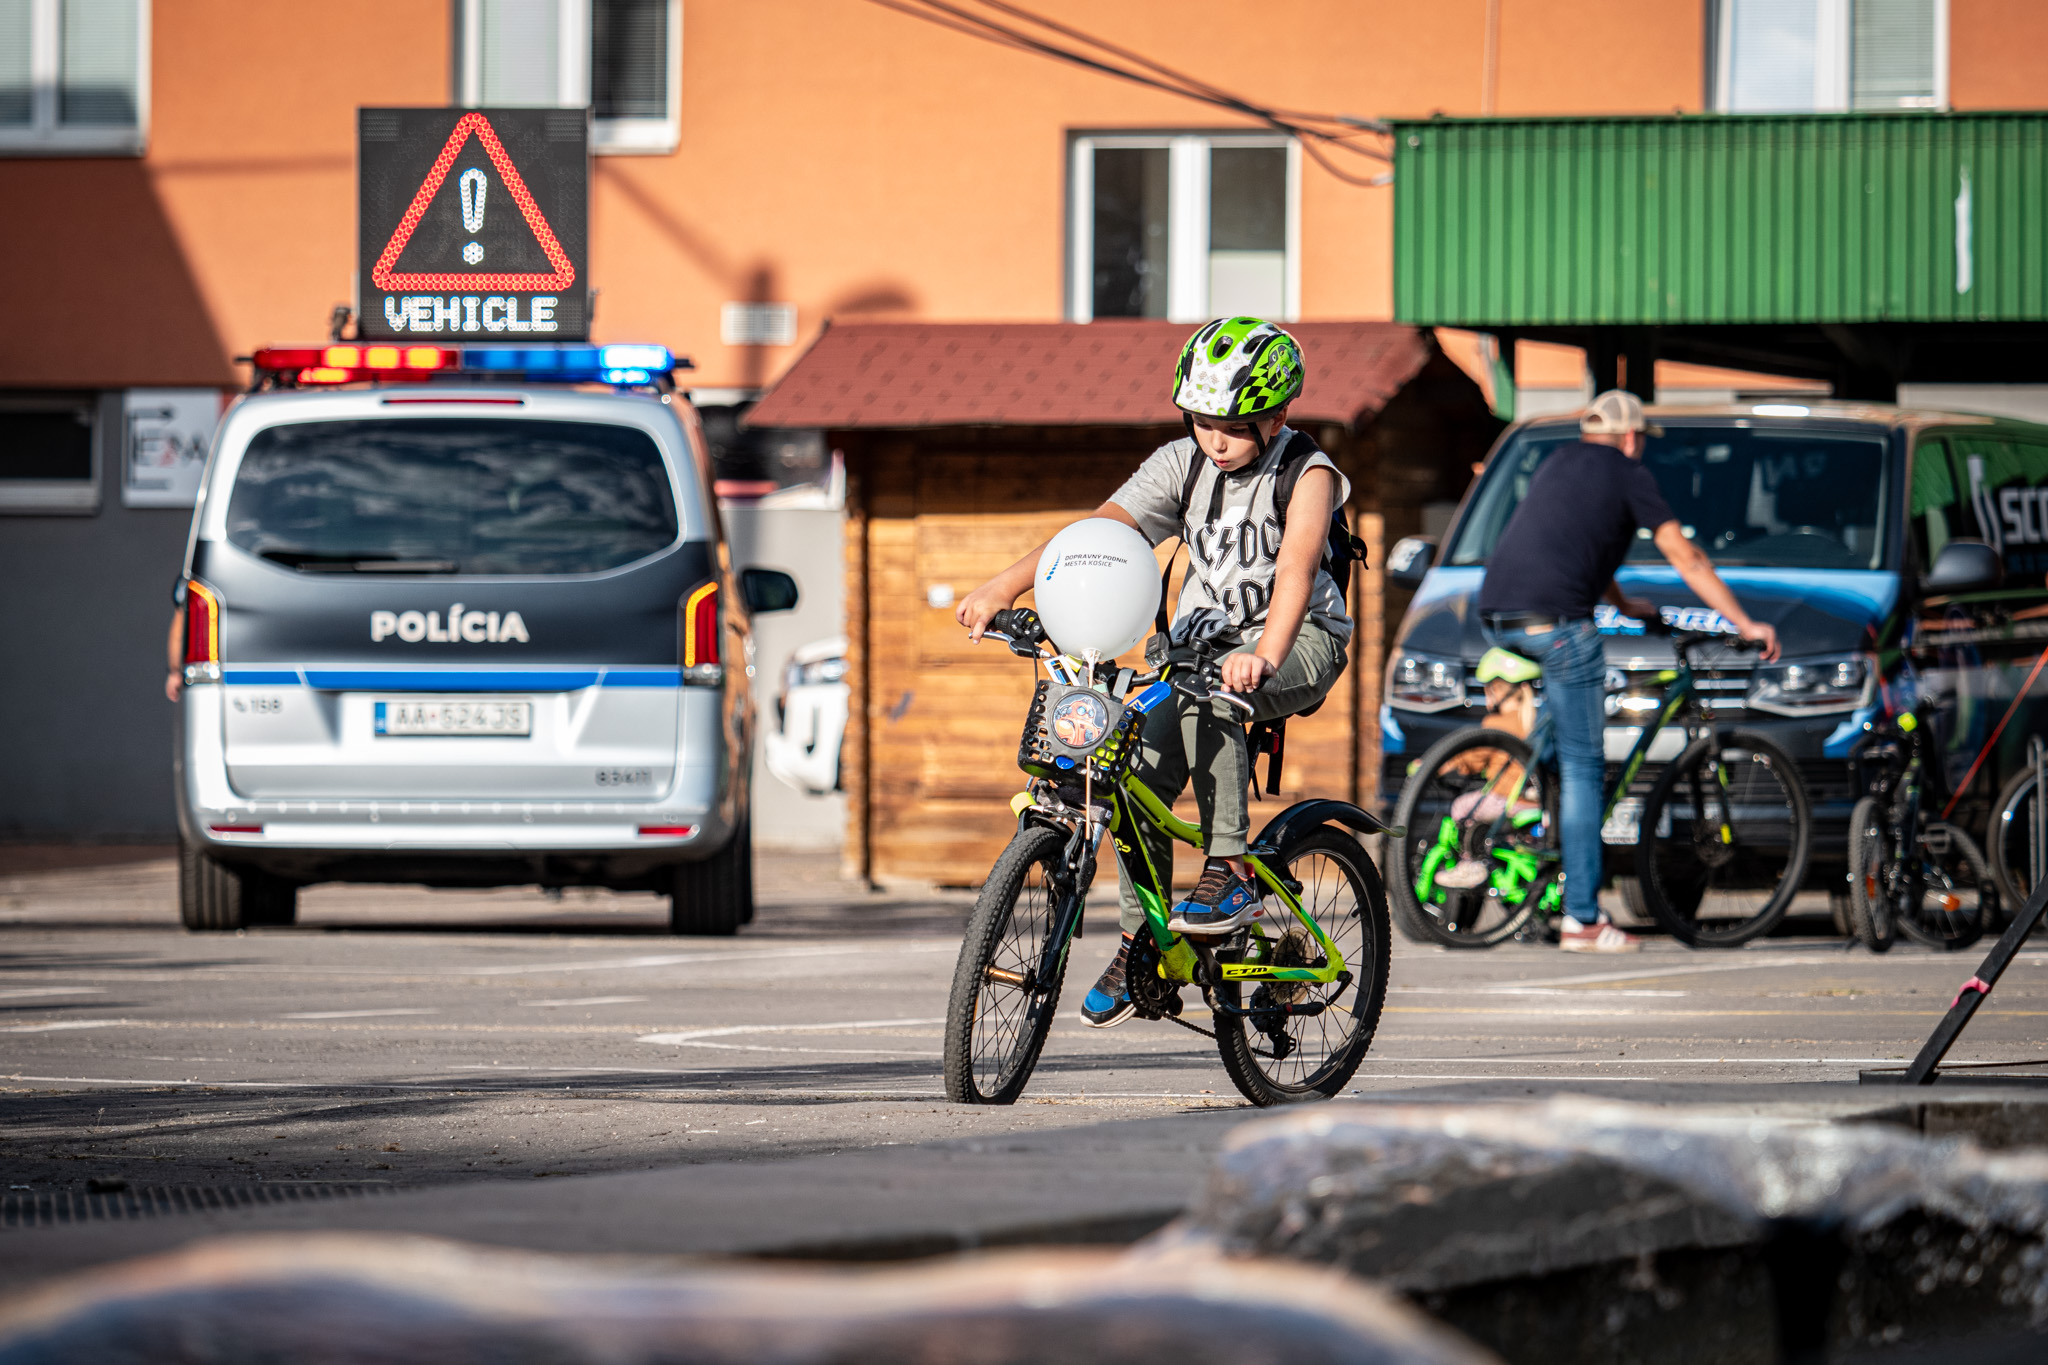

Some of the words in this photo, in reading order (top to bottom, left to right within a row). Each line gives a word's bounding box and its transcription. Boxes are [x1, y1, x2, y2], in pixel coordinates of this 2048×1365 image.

[384, 296, 558, 332] VEHICLE
[1102, 554, 1128, 564] PODNIK
[370, 603, 531, 643] POLÍCIA
[1226, 967, 1267, 976] CTM
